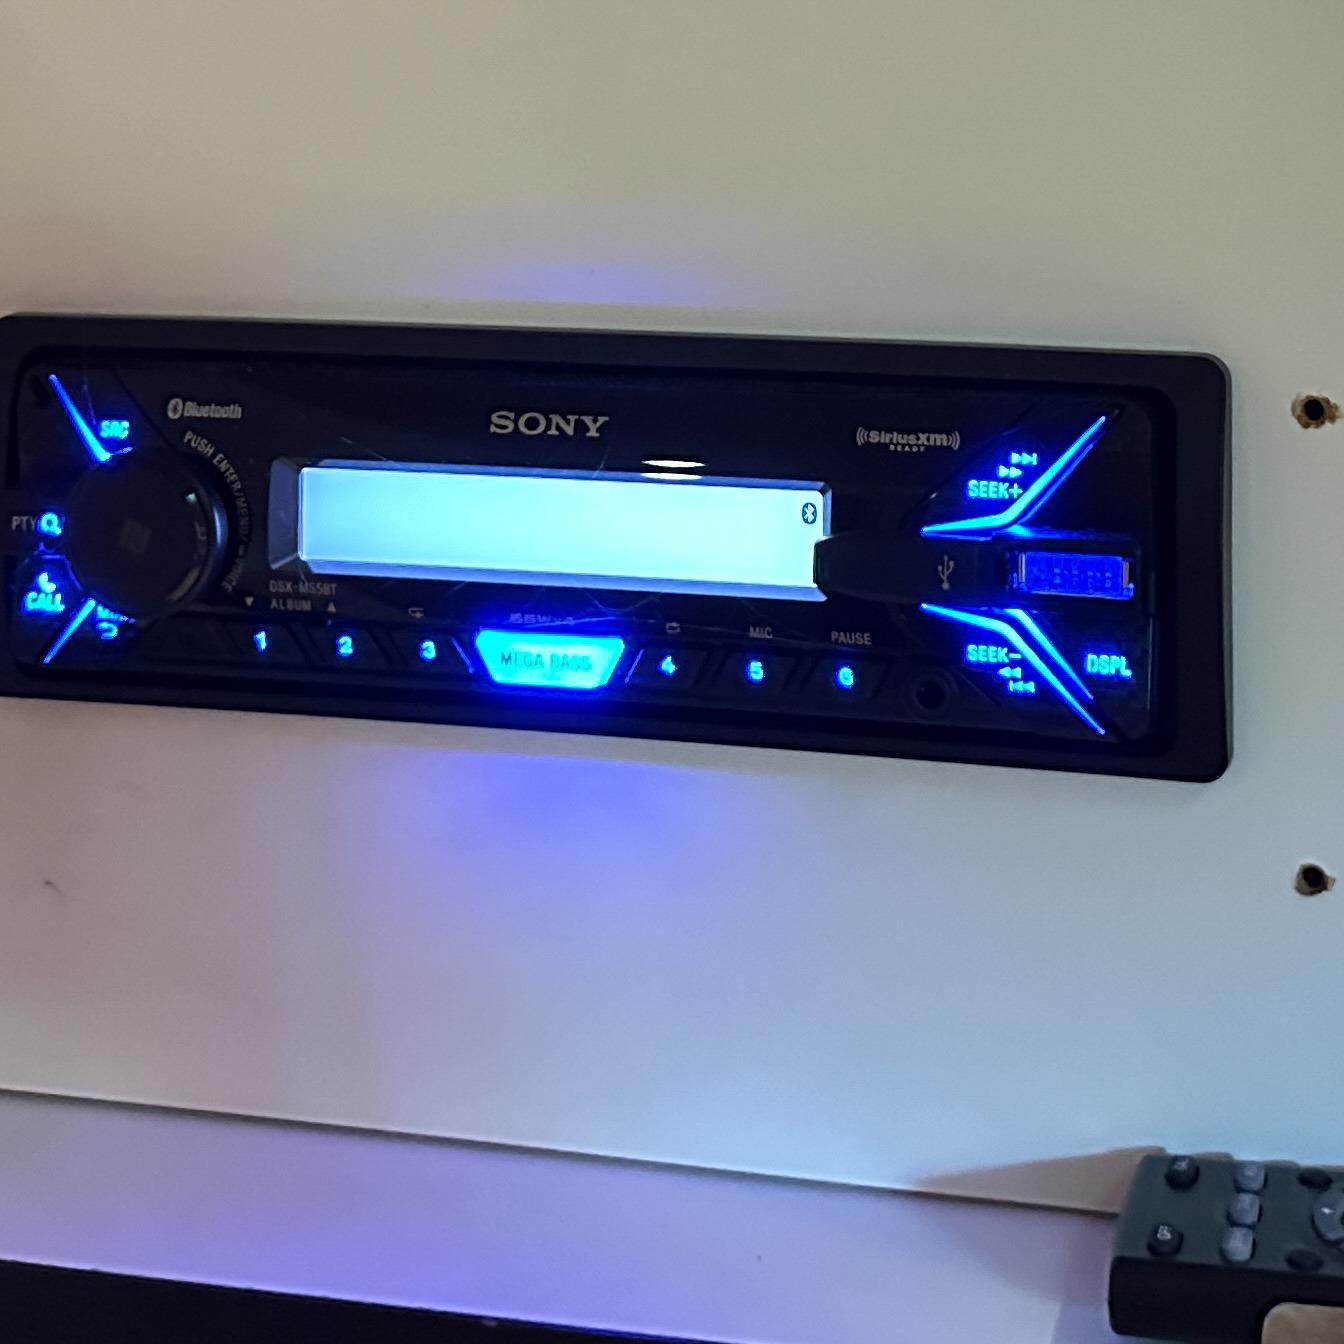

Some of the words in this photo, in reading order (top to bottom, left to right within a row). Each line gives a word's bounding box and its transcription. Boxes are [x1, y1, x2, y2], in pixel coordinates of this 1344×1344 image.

[184, 401, 242, 419] Bluetooth
[490, 411, 609, 437] SONY
[184, 430, 215, 456] PUSH
[889, 444, 925, 452] READY
[12, 516, 36, 530] PTY
[271, 598, 312, 612] ALBUM
[255, 630, 267, 650] 1
[750, 626, 772, 639] MIC
[831, 631, 871, 645] PAUSE
[337, 635, 353, 655] 2
[421, 640, 436, 659] 3
[501, 651, 544, 668] MEGA
[661, 656, 676, 675] 4
[1087, 654, 1132, 677] DSPL
[749, 661, 764, 679] 5
